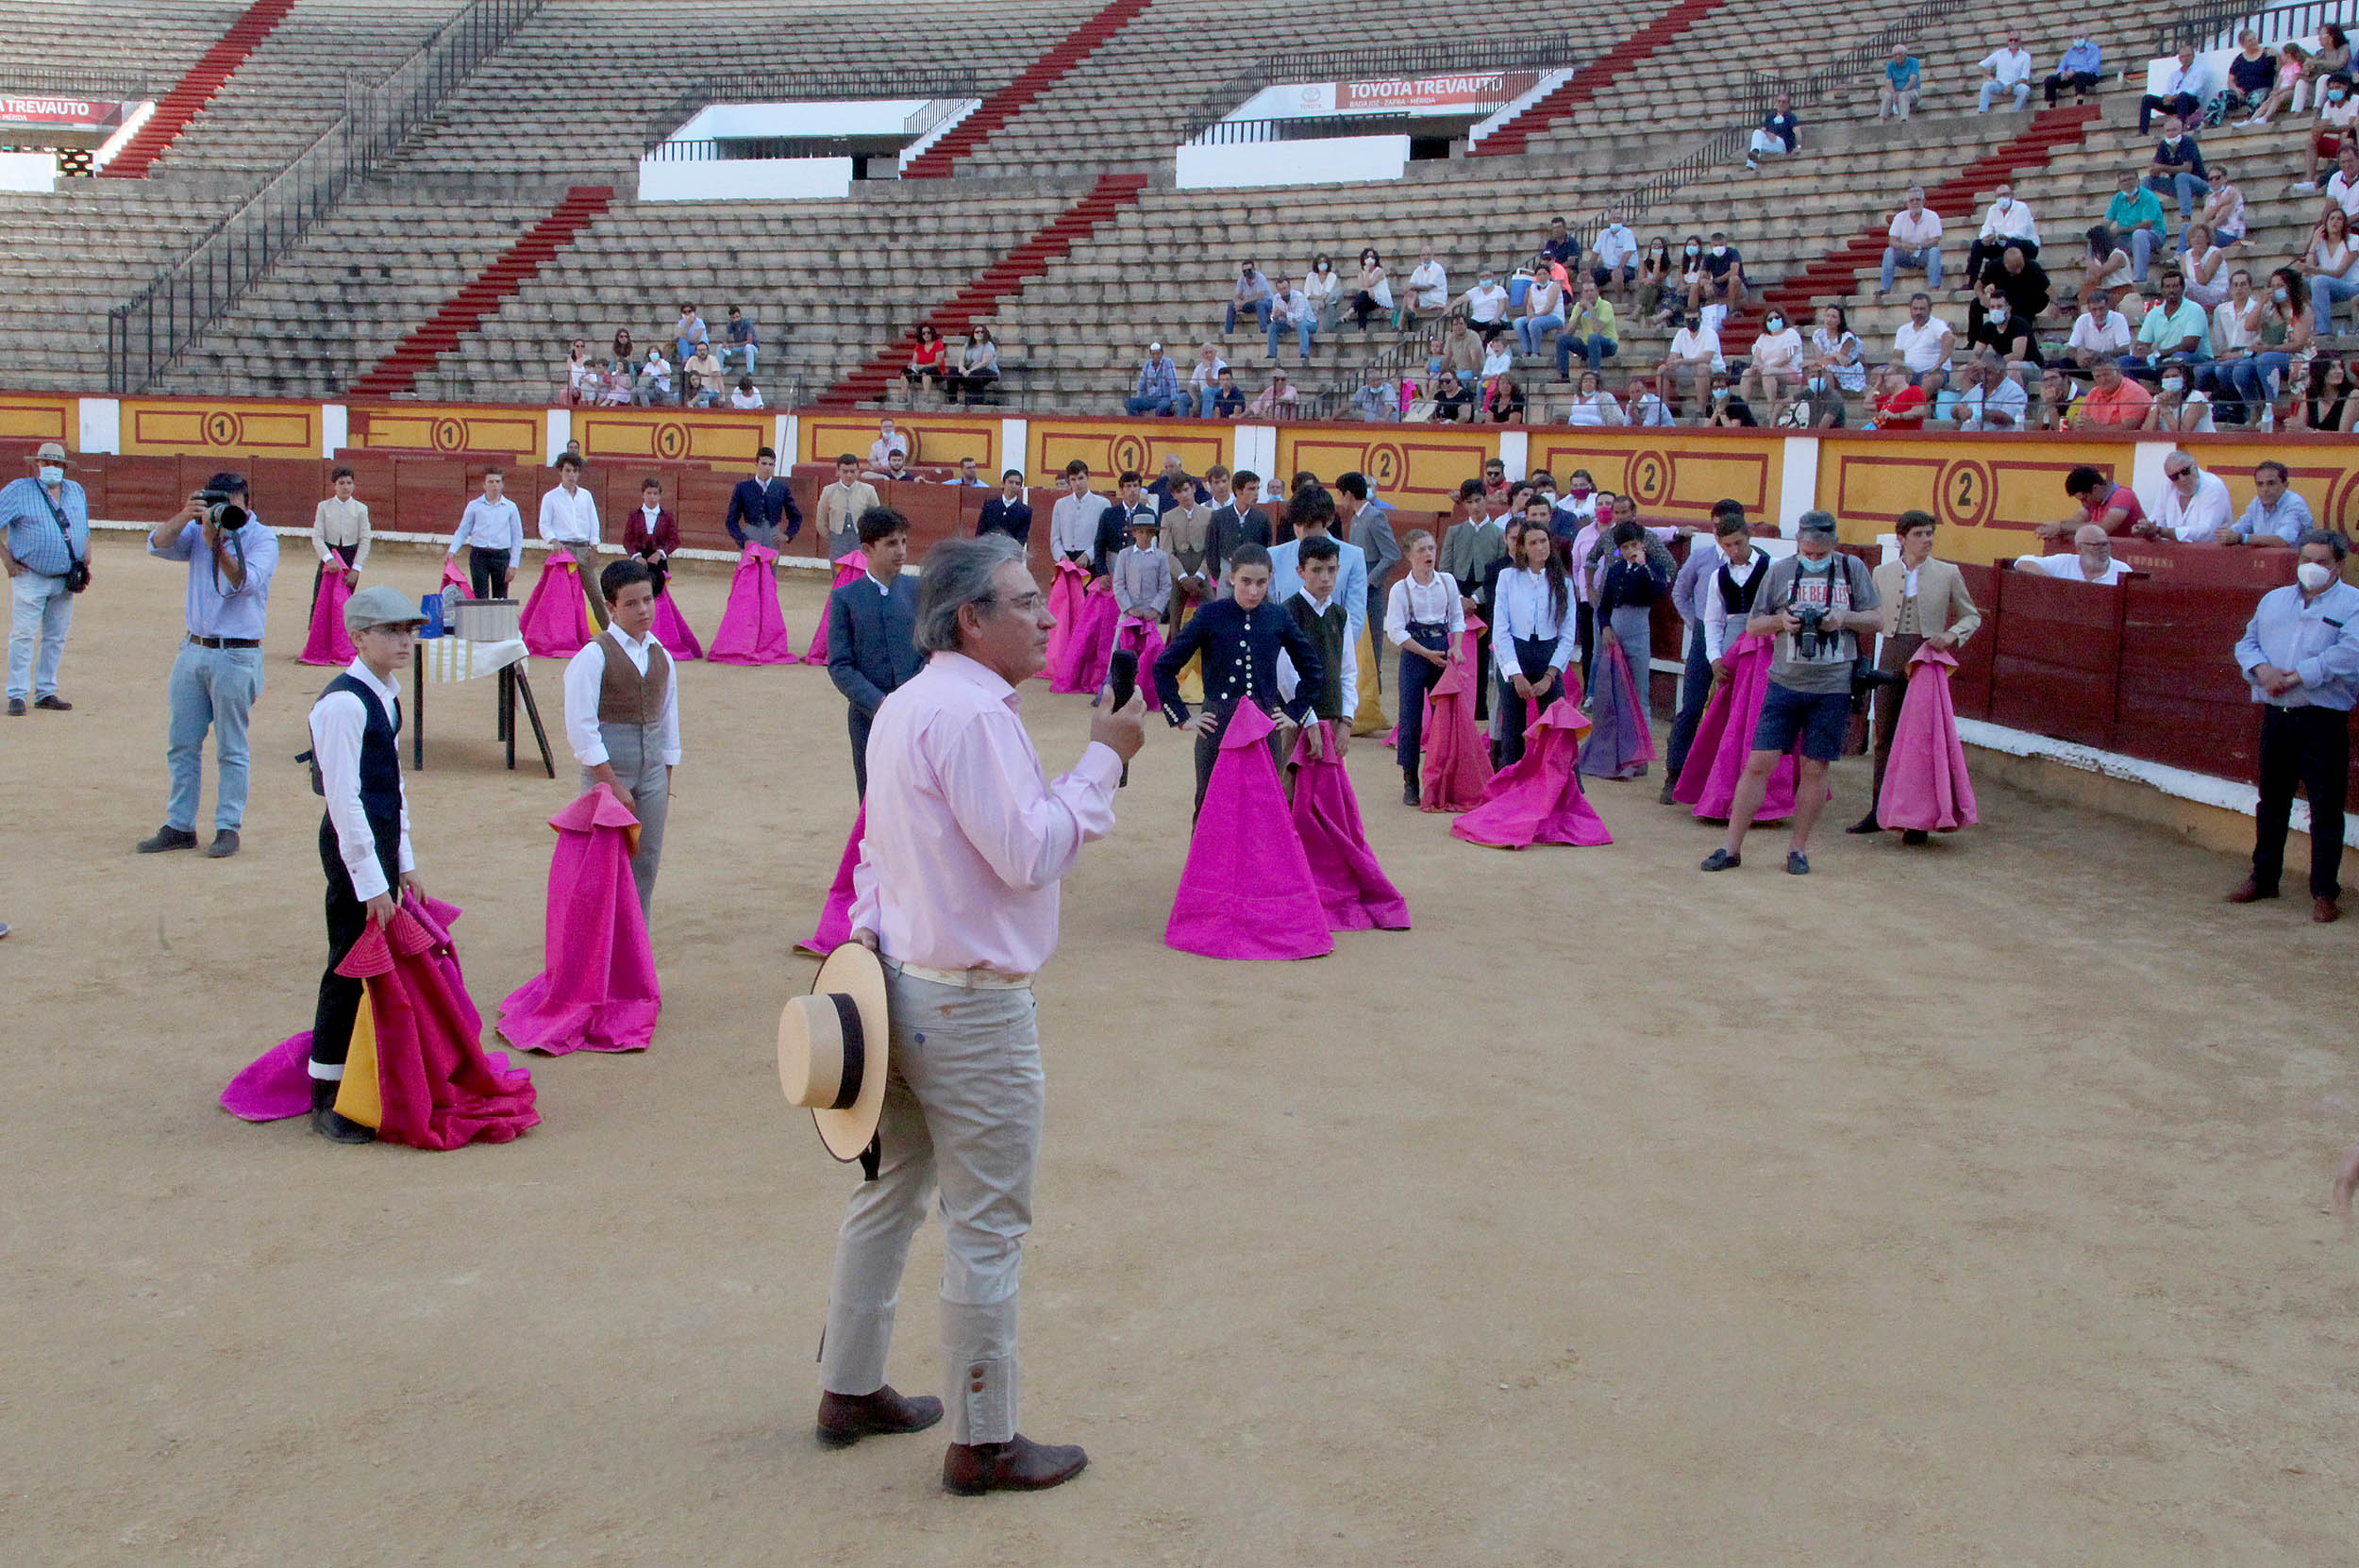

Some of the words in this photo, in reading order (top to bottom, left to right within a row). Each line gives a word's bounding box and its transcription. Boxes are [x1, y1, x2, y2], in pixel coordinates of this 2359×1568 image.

[1349, 82, 1413, 98] TOYOTA
[1415, 76, 1503, 94] TREVAUTO
[6, 99, 90, 116] TREVAUTO
[1349, 99, 1380, 108] BADAJOZ
[1383, 98, 1406, 107] ZAFRA
[215, 419, 226, 437] 1
[443, 425, 453, 443] 1
[665, 432, 675, 451] 1
[1124, 446, 1134, 468] 1
[1380, 453, 1391, 477] 2
[1645, 463, 1656, 491] 2
[1958, 472, 1973, 507] 2
[1810, 585, 1849, 605] BEALES
